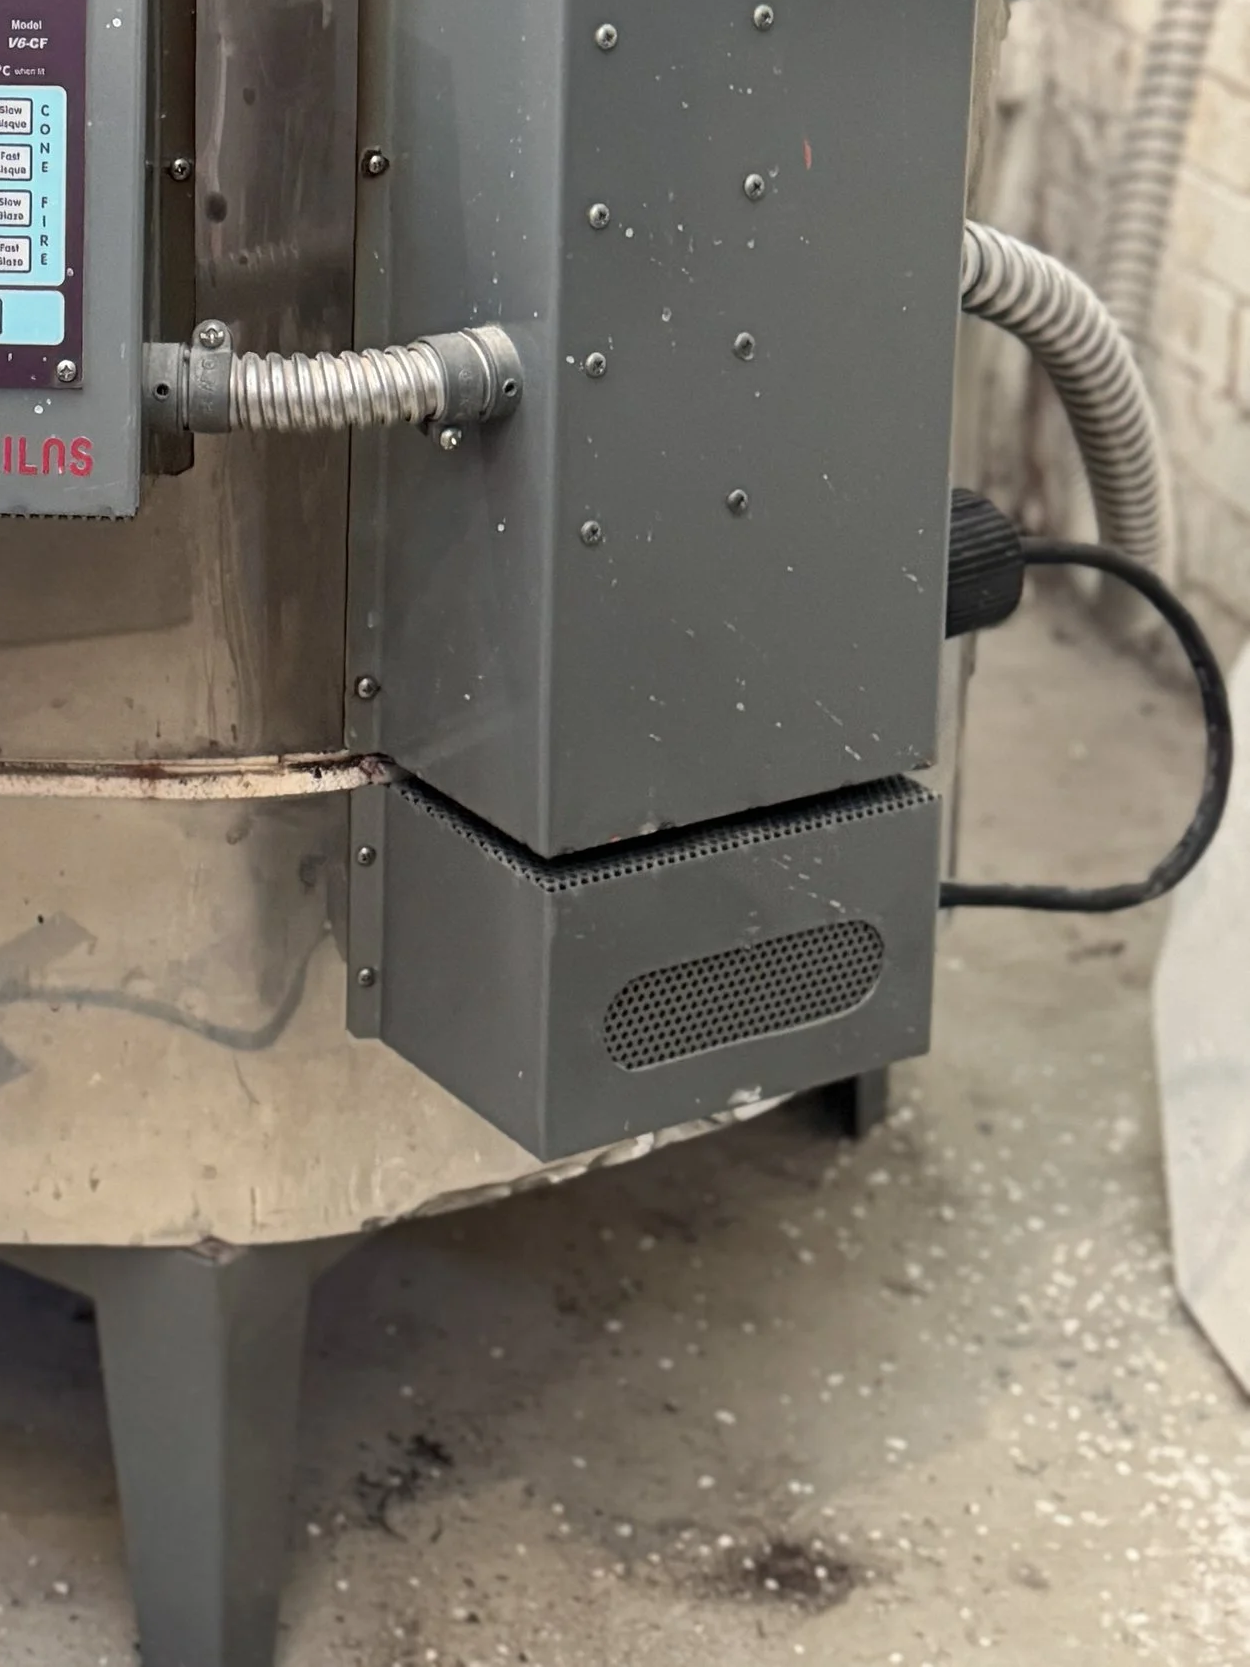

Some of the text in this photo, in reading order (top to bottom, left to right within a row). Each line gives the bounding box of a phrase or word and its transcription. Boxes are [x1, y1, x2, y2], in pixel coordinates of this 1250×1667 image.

[11, 20, 42, 30] Model
[8, 37, 48, 50] V6-CF
[14, 67, 37, 76] when
[0, 106, 22, 115] Slow
[0, 152, 20, 161] Fast
[40, 105, 50, 265] CONE FIRE
[0, 244, 19, 253] Fast
